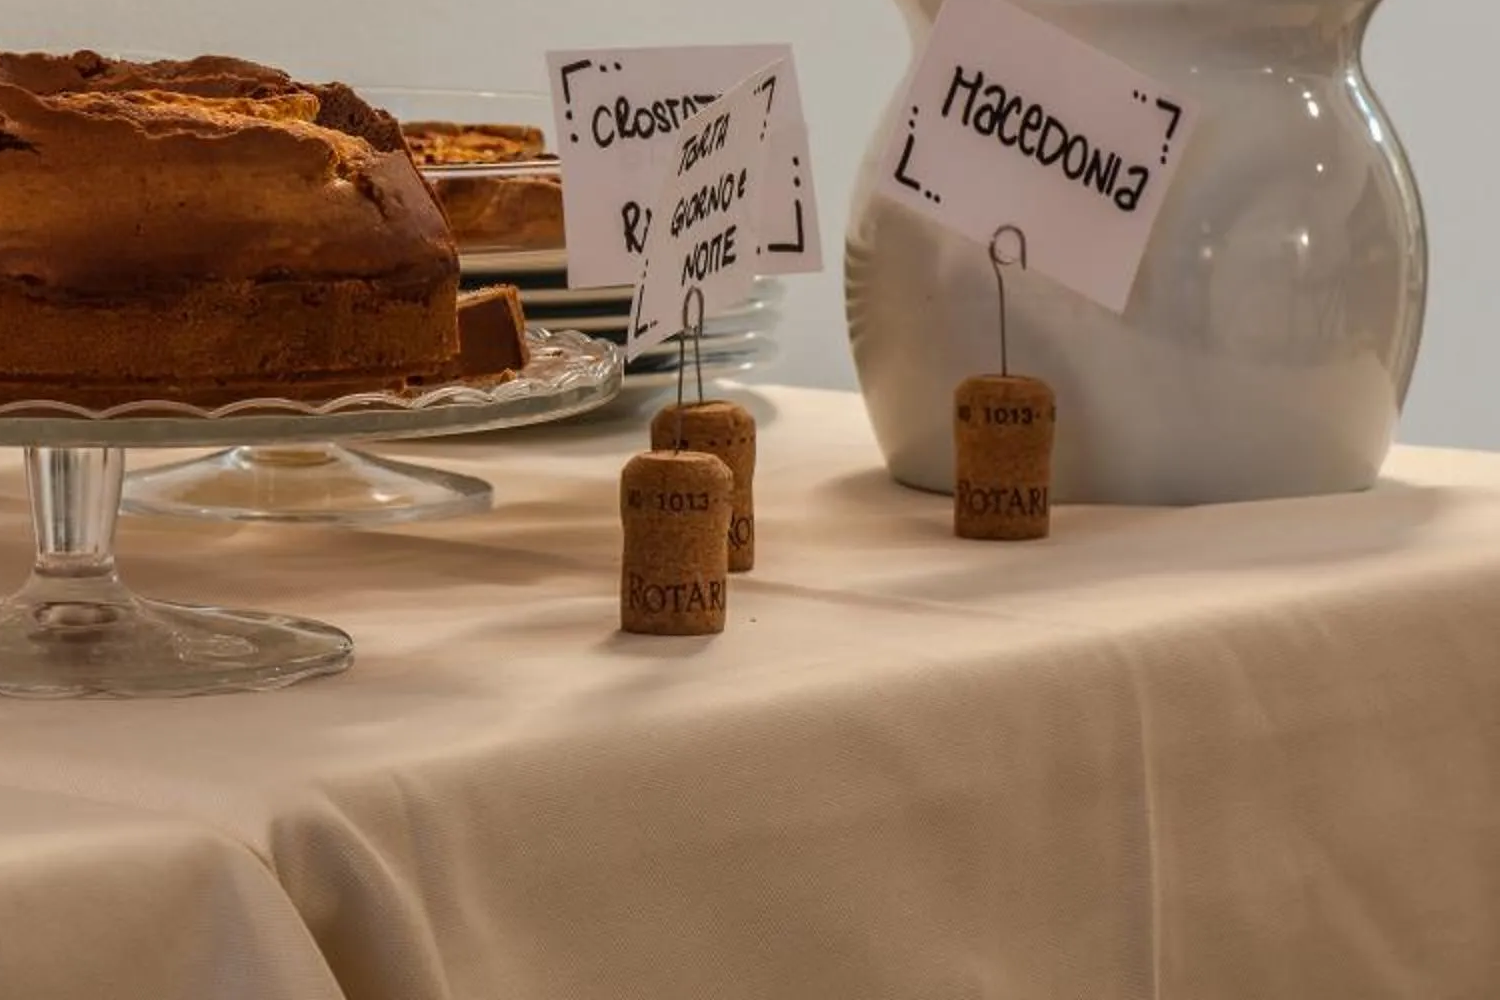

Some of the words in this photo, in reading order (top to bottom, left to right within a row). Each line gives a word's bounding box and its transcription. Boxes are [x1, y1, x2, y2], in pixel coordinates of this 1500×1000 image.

[677, 112, 730, 177] TORTA
[671, 173, 734, 238] GIORNO
[681, 224, 736, 287] NOTTE
